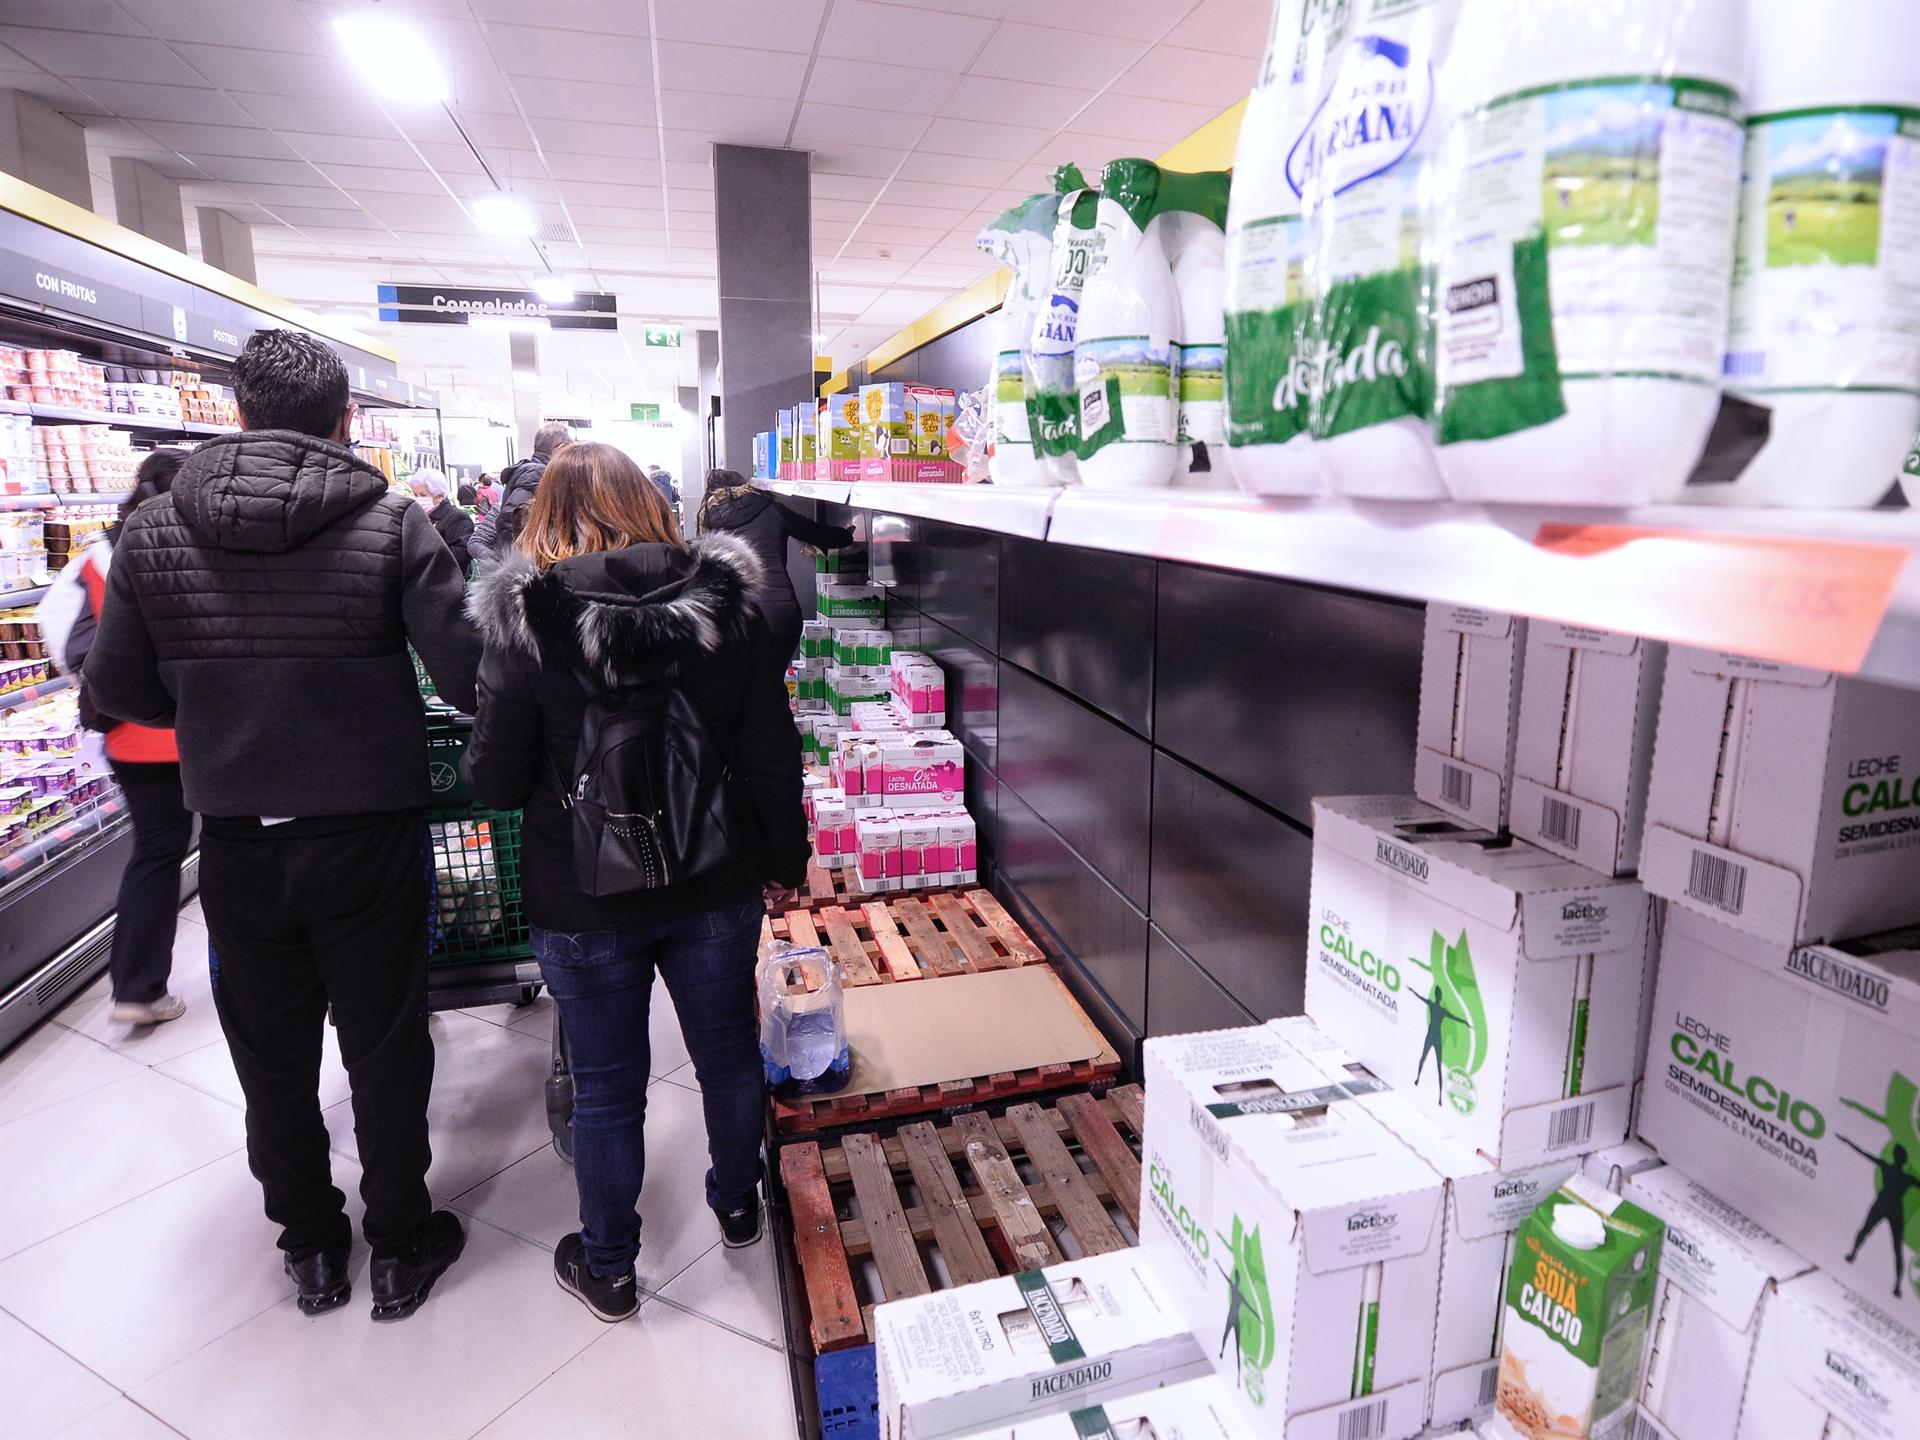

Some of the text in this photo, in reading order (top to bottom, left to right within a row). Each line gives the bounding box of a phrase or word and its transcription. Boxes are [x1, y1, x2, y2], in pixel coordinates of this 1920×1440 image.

[36, 272, 97, 304] CON FRUTAS
[432, 295, 549, 317] Congelados
[831, 608, 881, 616] SEMIDESNATADA
[887, 781, 938, 792] DESNATADA
[1847, 755, 1900, 778] LECHE
[1376, 840, 1430, 880] HACENDADO
[1321, 907, 1351, 934] LECHE
[1319, 923, 1402, 994] CALCIO
[1786, 948, 1890, 1008] HACENDADO
[1319, 950, 1399, 1013] SEMIDESNATADA
[1675, 1011, 1731, 1054] LECHE
[1665, 1079, 1681, 1096] CON
[1681, 1088, 1721, 1122] VITAMINAS
[1670, 1032, 1827, 1140] CALCIO
[1668, 1064, 1819, 1167] SEMIDESNATADA
[1150, 1163, 1210, 1260] CALCIO
[968, 1310, 995, 1352] 6x1 LITRO
[1027, 1287, 1070, 1344] HACENDADO
[1520, 1282, 1583, 1348] CALCIO
[1031, 1361, 1112, 1399] HACENDADO
